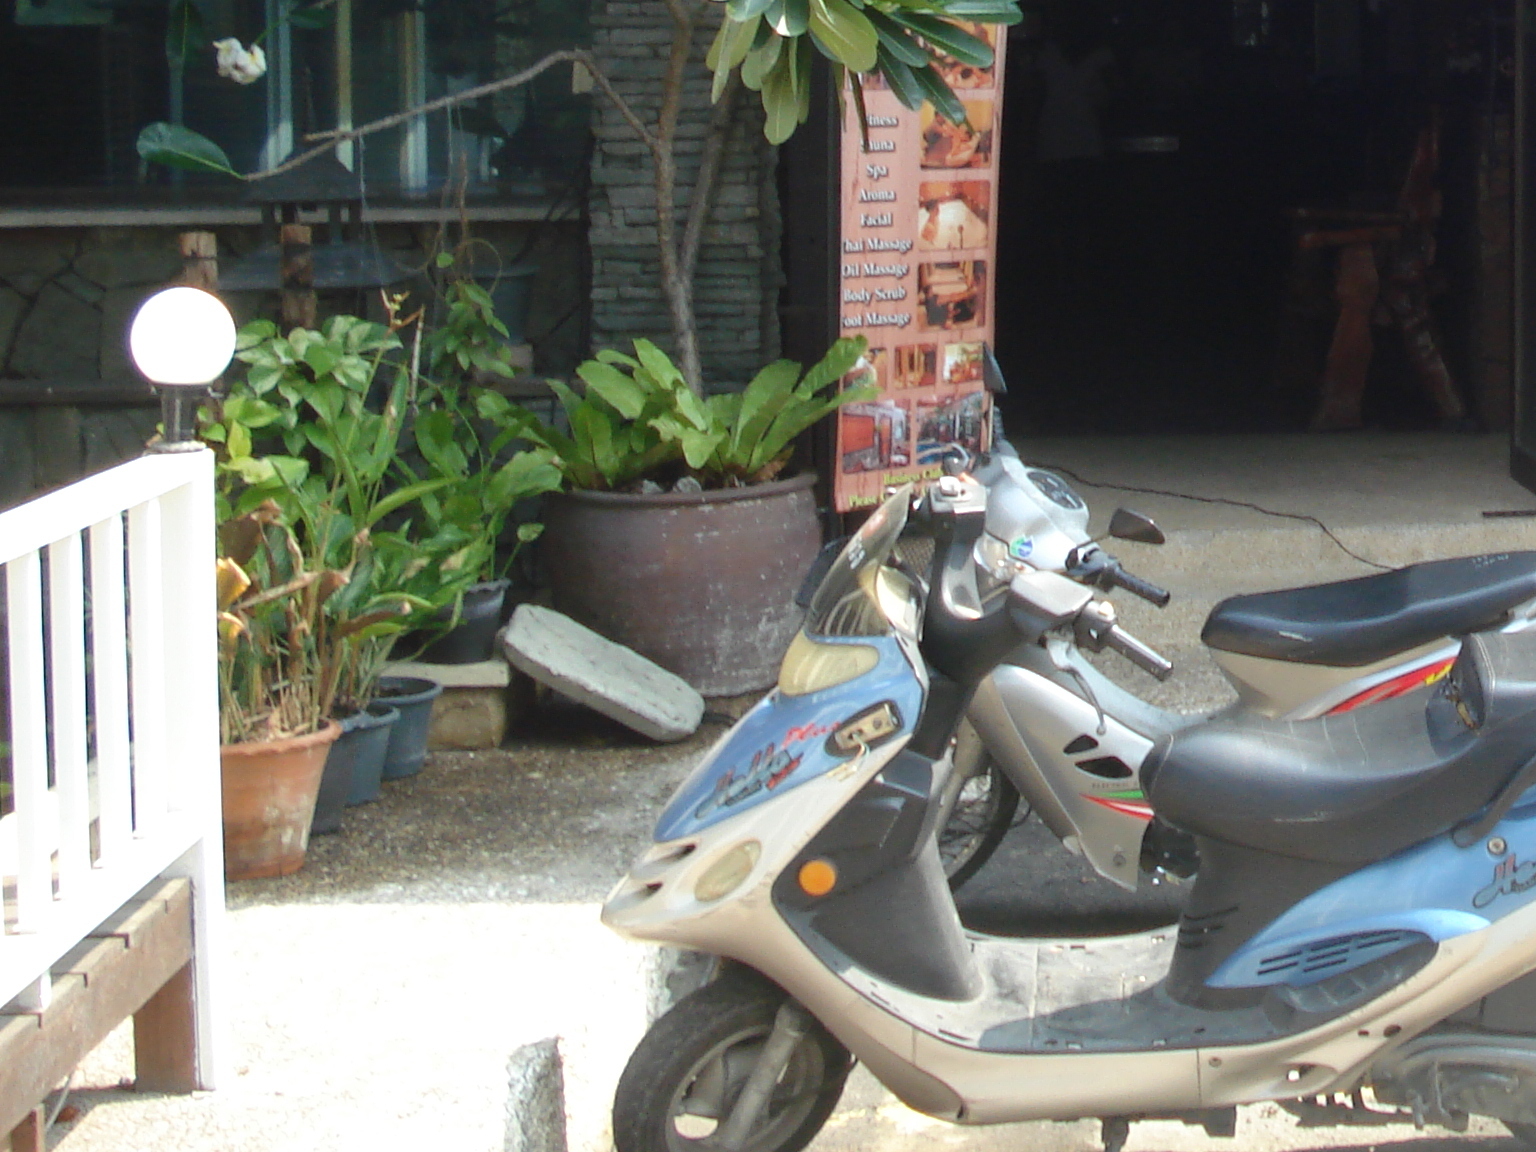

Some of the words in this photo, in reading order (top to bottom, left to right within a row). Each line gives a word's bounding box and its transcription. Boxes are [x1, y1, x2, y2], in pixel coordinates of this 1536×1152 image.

[866, 164, 888, 181] Spa
[859, 188, 896, 203] Aroma
[861, 213, 893, 227] Facial
[867, 237, 914, 254] Massage
[842, 262, 860, 278] Oil
[864, 262, 910, 279] Massage
[844, 288, 873, 305] Body
[875, 285, 907, 301] Scrub
[865, 312, 911, 329] Massage
